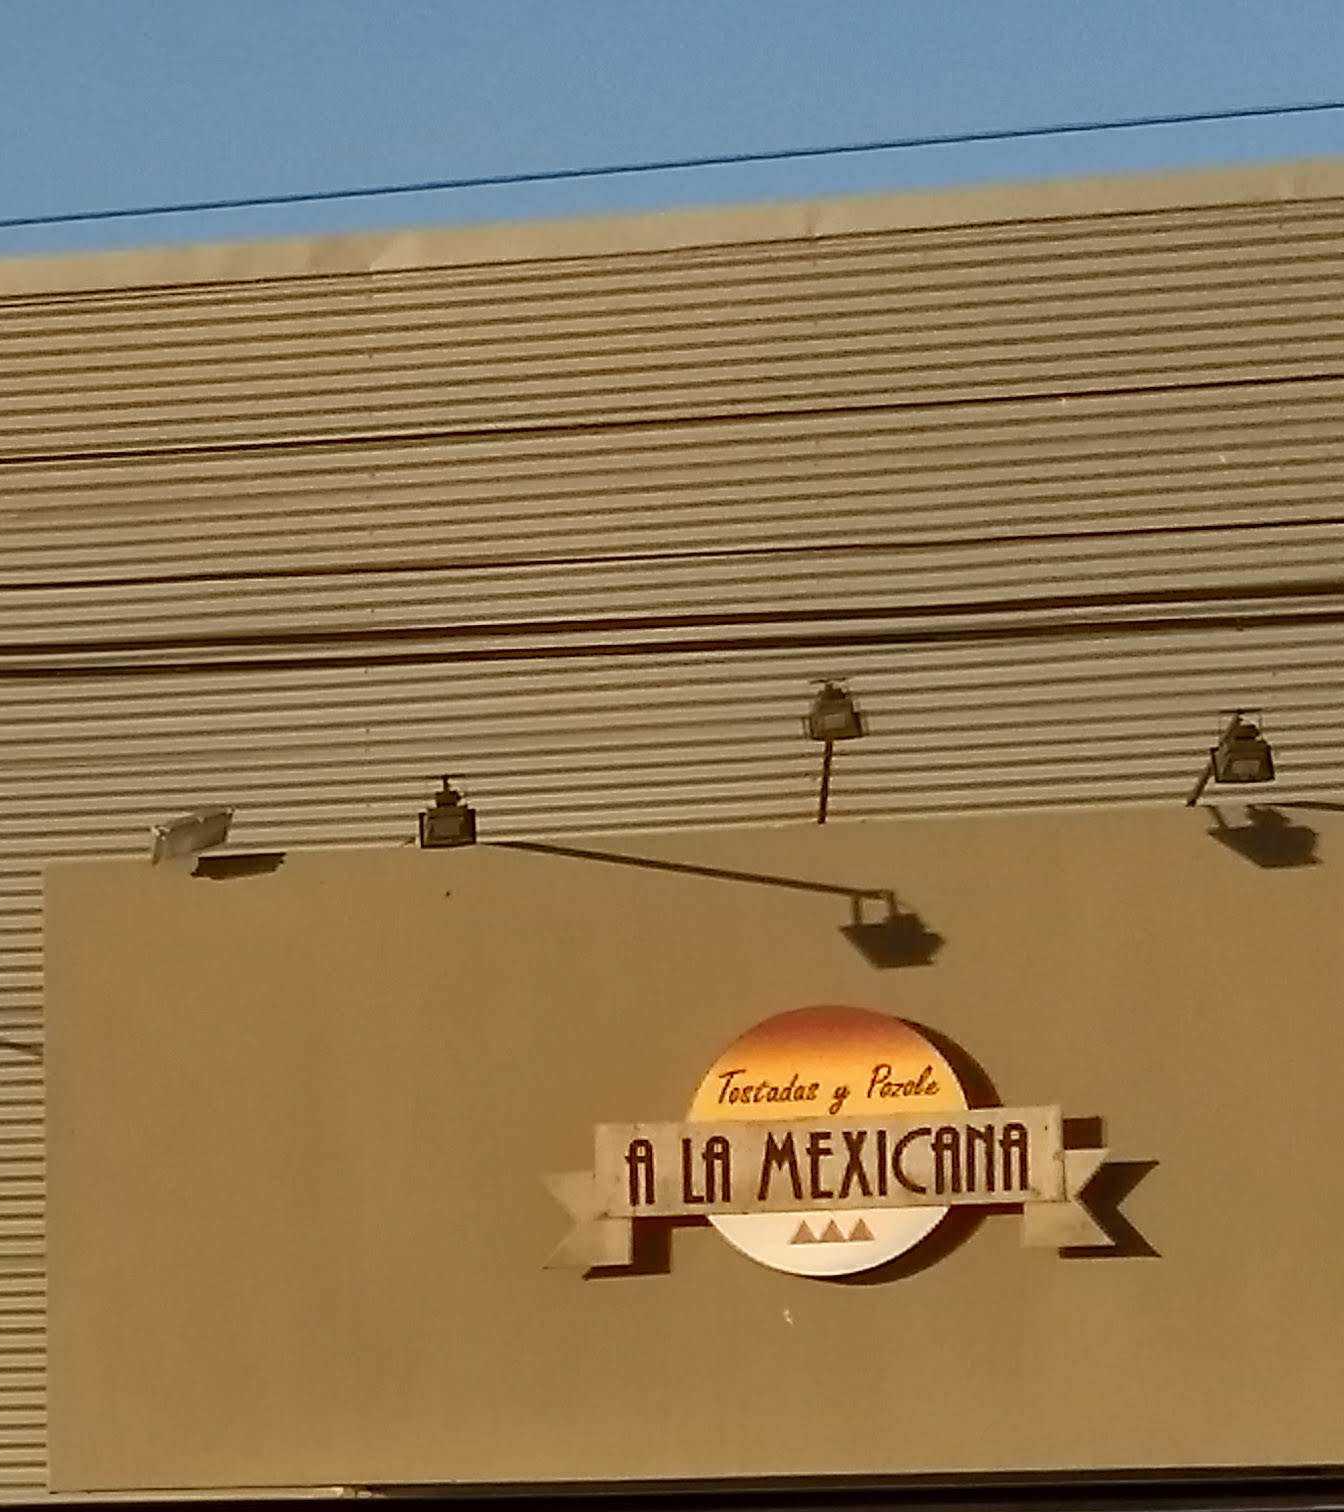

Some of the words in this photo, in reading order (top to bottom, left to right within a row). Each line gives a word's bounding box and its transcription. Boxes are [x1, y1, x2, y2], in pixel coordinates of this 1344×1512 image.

[717, 1069, 818, 1104] Tostadas
[832, 1084, 850, 1114] y
[865, 1064, 939, 1099] Pozole
[625, 1138, 656, 1206] A
[682, 1134, 733, 1204] LA
[758, 1123, 1030, 1202] MEXICANA
